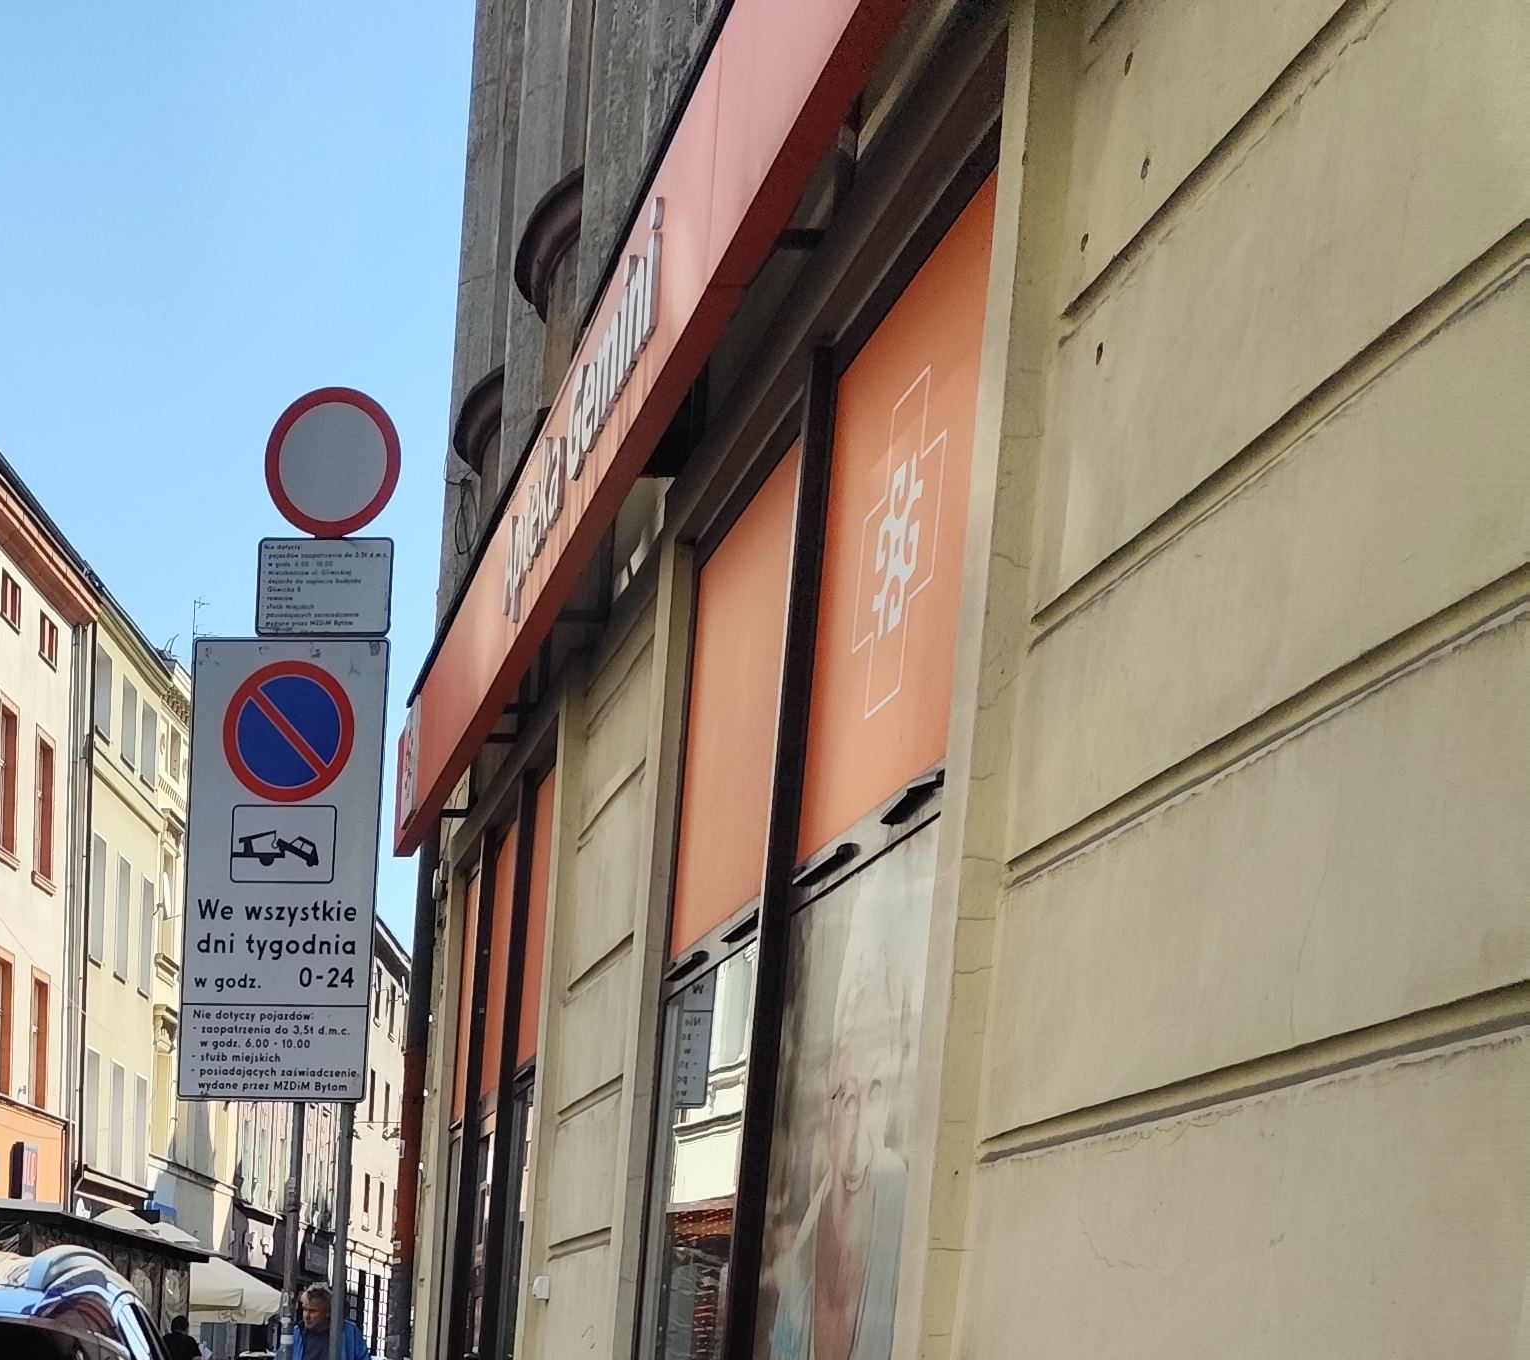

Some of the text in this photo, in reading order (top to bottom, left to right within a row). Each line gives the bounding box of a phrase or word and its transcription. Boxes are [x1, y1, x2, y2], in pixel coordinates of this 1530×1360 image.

[503, 196, 665, 623] Apteka Gemini
[198, 899, 357, 927] We wszystkie
[197, 933, 356, 960] dni tygodnia
[194, 977, 207, 988] w
[214, 973, 262, 992] godz.
[193, 1009, 315, 1022] Nie dotyczy pojazdów:
[201, 1025, 271, 1036] zaopatrzenia
[275, 1025, 288, 1035] do
[318, 1026, 350, 1036] d.m.c.
[199, 1040, 209, 1048] w
[245, 1038, 269, 1048] 6.00
[281, 1038, 311, 1049] 10.00
[200, 1052, 228, 1062] służb
[231, 1052, 281, 1064] miejskich
[199, 1066, 277, 1078] posiadających
[280, 1067, 357, 1078] zaświadczenie
[198, 1080, 348, 1093] wydane przez MZDiM Bytom
